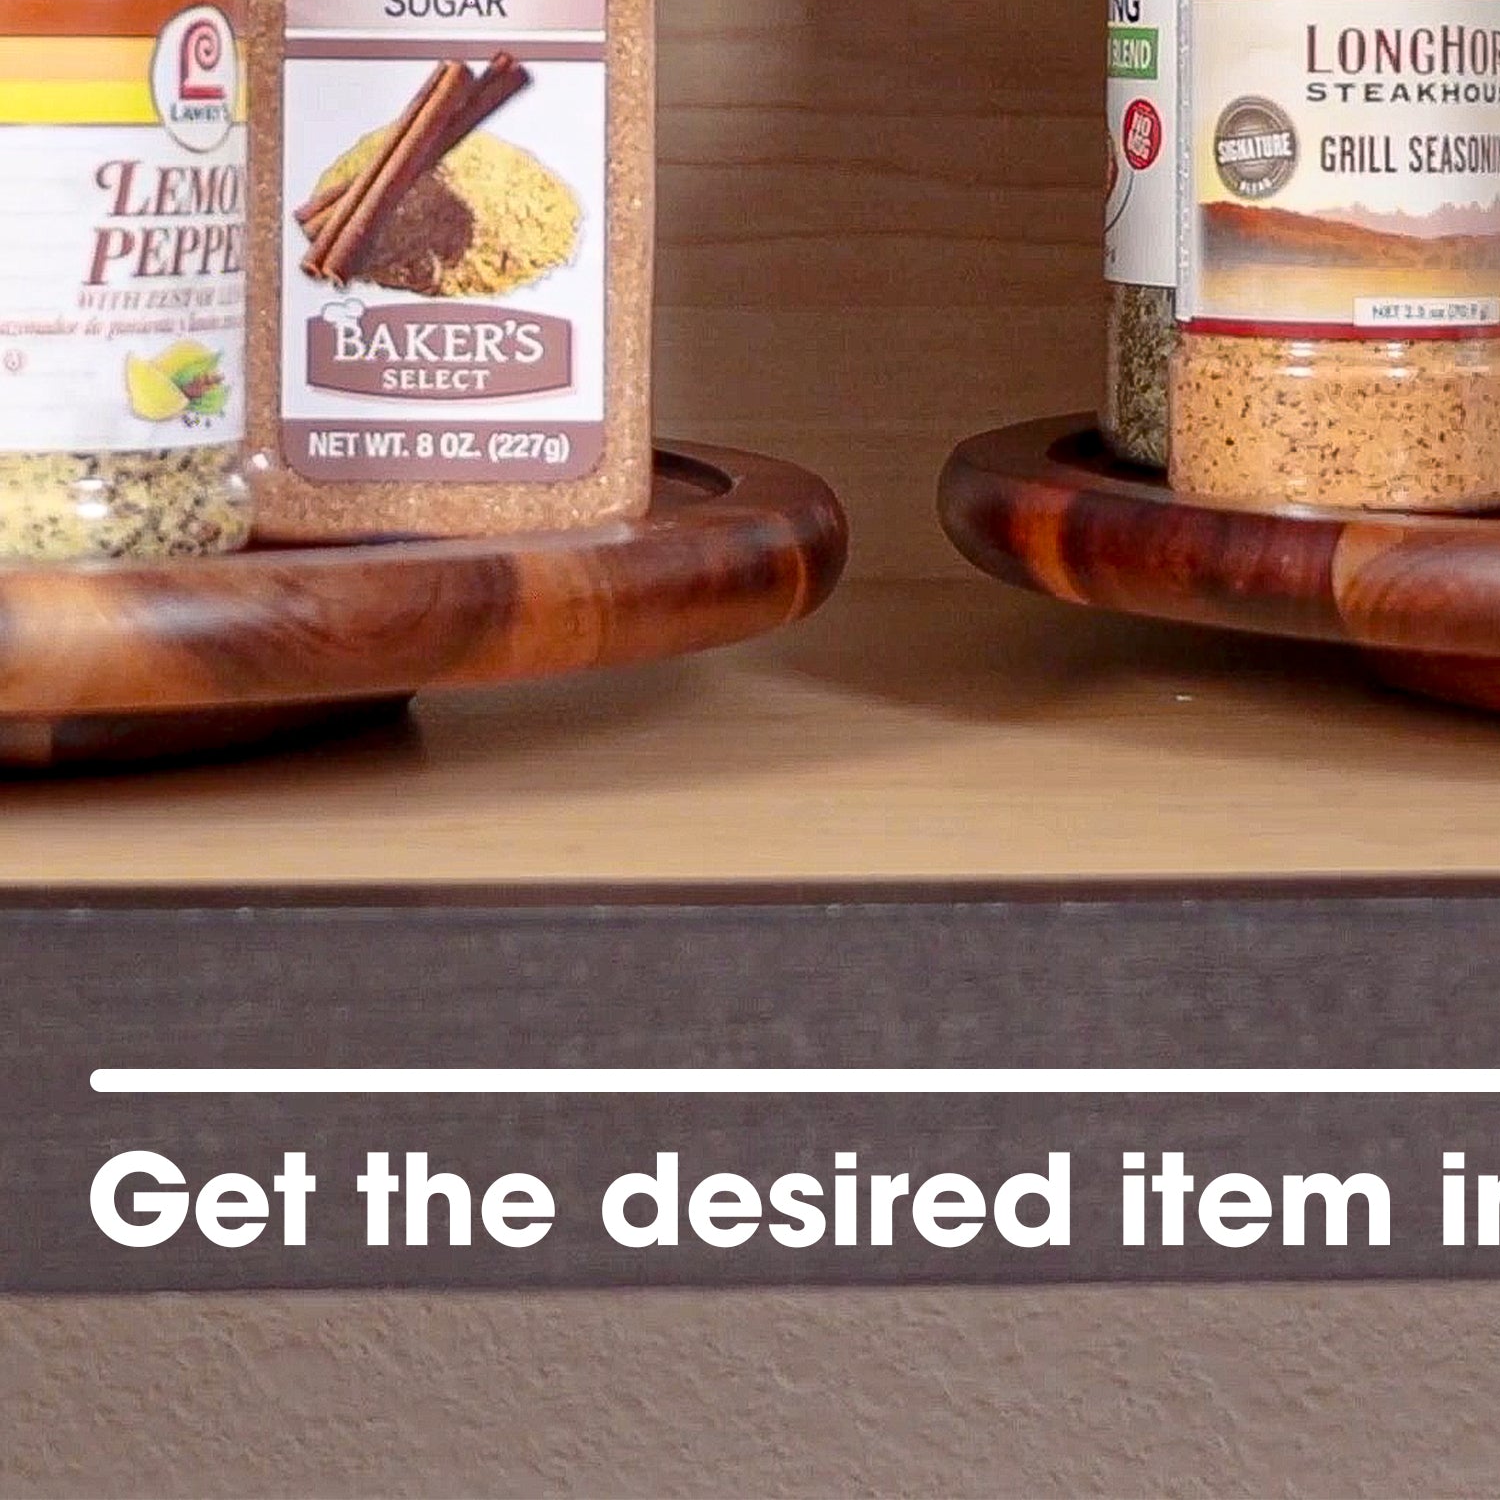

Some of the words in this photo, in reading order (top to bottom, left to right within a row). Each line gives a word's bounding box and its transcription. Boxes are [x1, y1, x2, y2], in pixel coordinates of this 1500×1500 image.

[1321, 135, 1397, 173] GRILL
[333, 319, 545, 363] BAKER'S
[382, 369, 490, 391] SELECT
[309, 431, 361, 458] NET
[364, 432, 409, 458] WT.
[416, 433, 434, 458] 8
[440, 432, 482, 459] OZ.
[488, 432, 571, 463] (227g)
